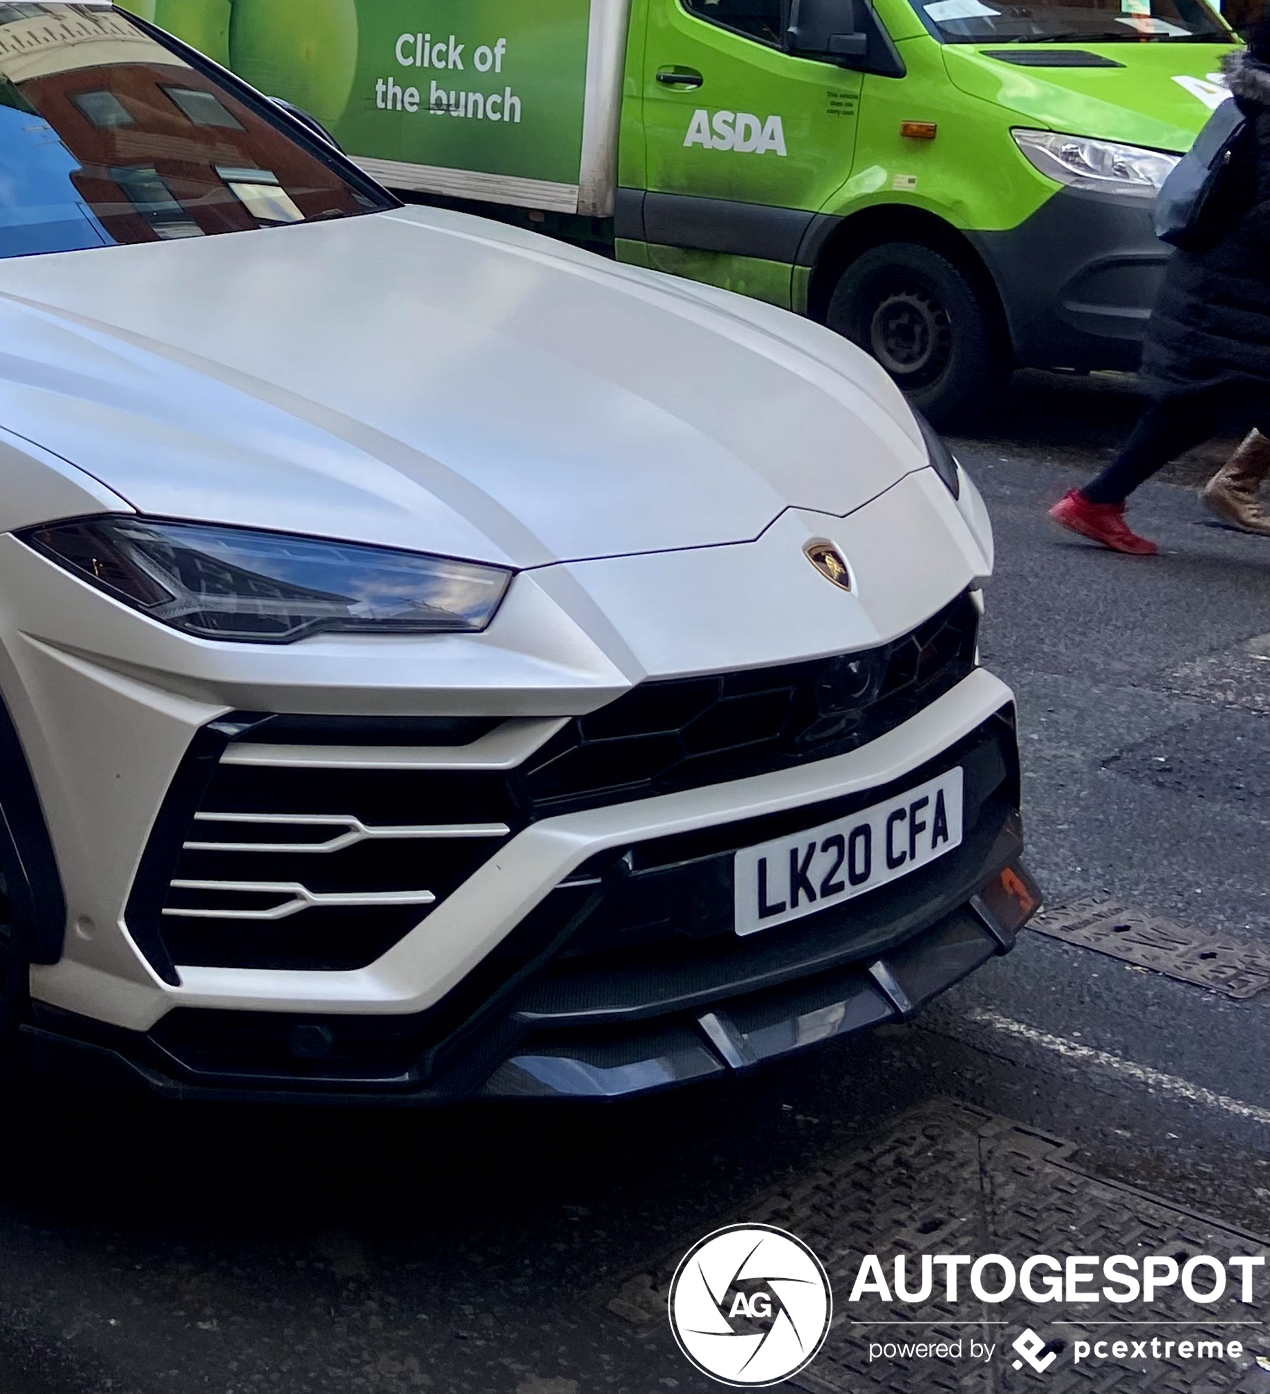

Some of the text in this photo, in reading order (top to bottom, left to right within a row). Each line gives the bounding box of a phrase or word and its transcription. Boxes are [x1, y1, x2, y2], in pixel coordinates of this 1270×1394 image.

[395, 33, 507, 73] Click of
[375, 76, 522, 123] the bunch
[682, 109, 787, 156] ASDA
[757, 788, 949, 920] LK20 CFA
